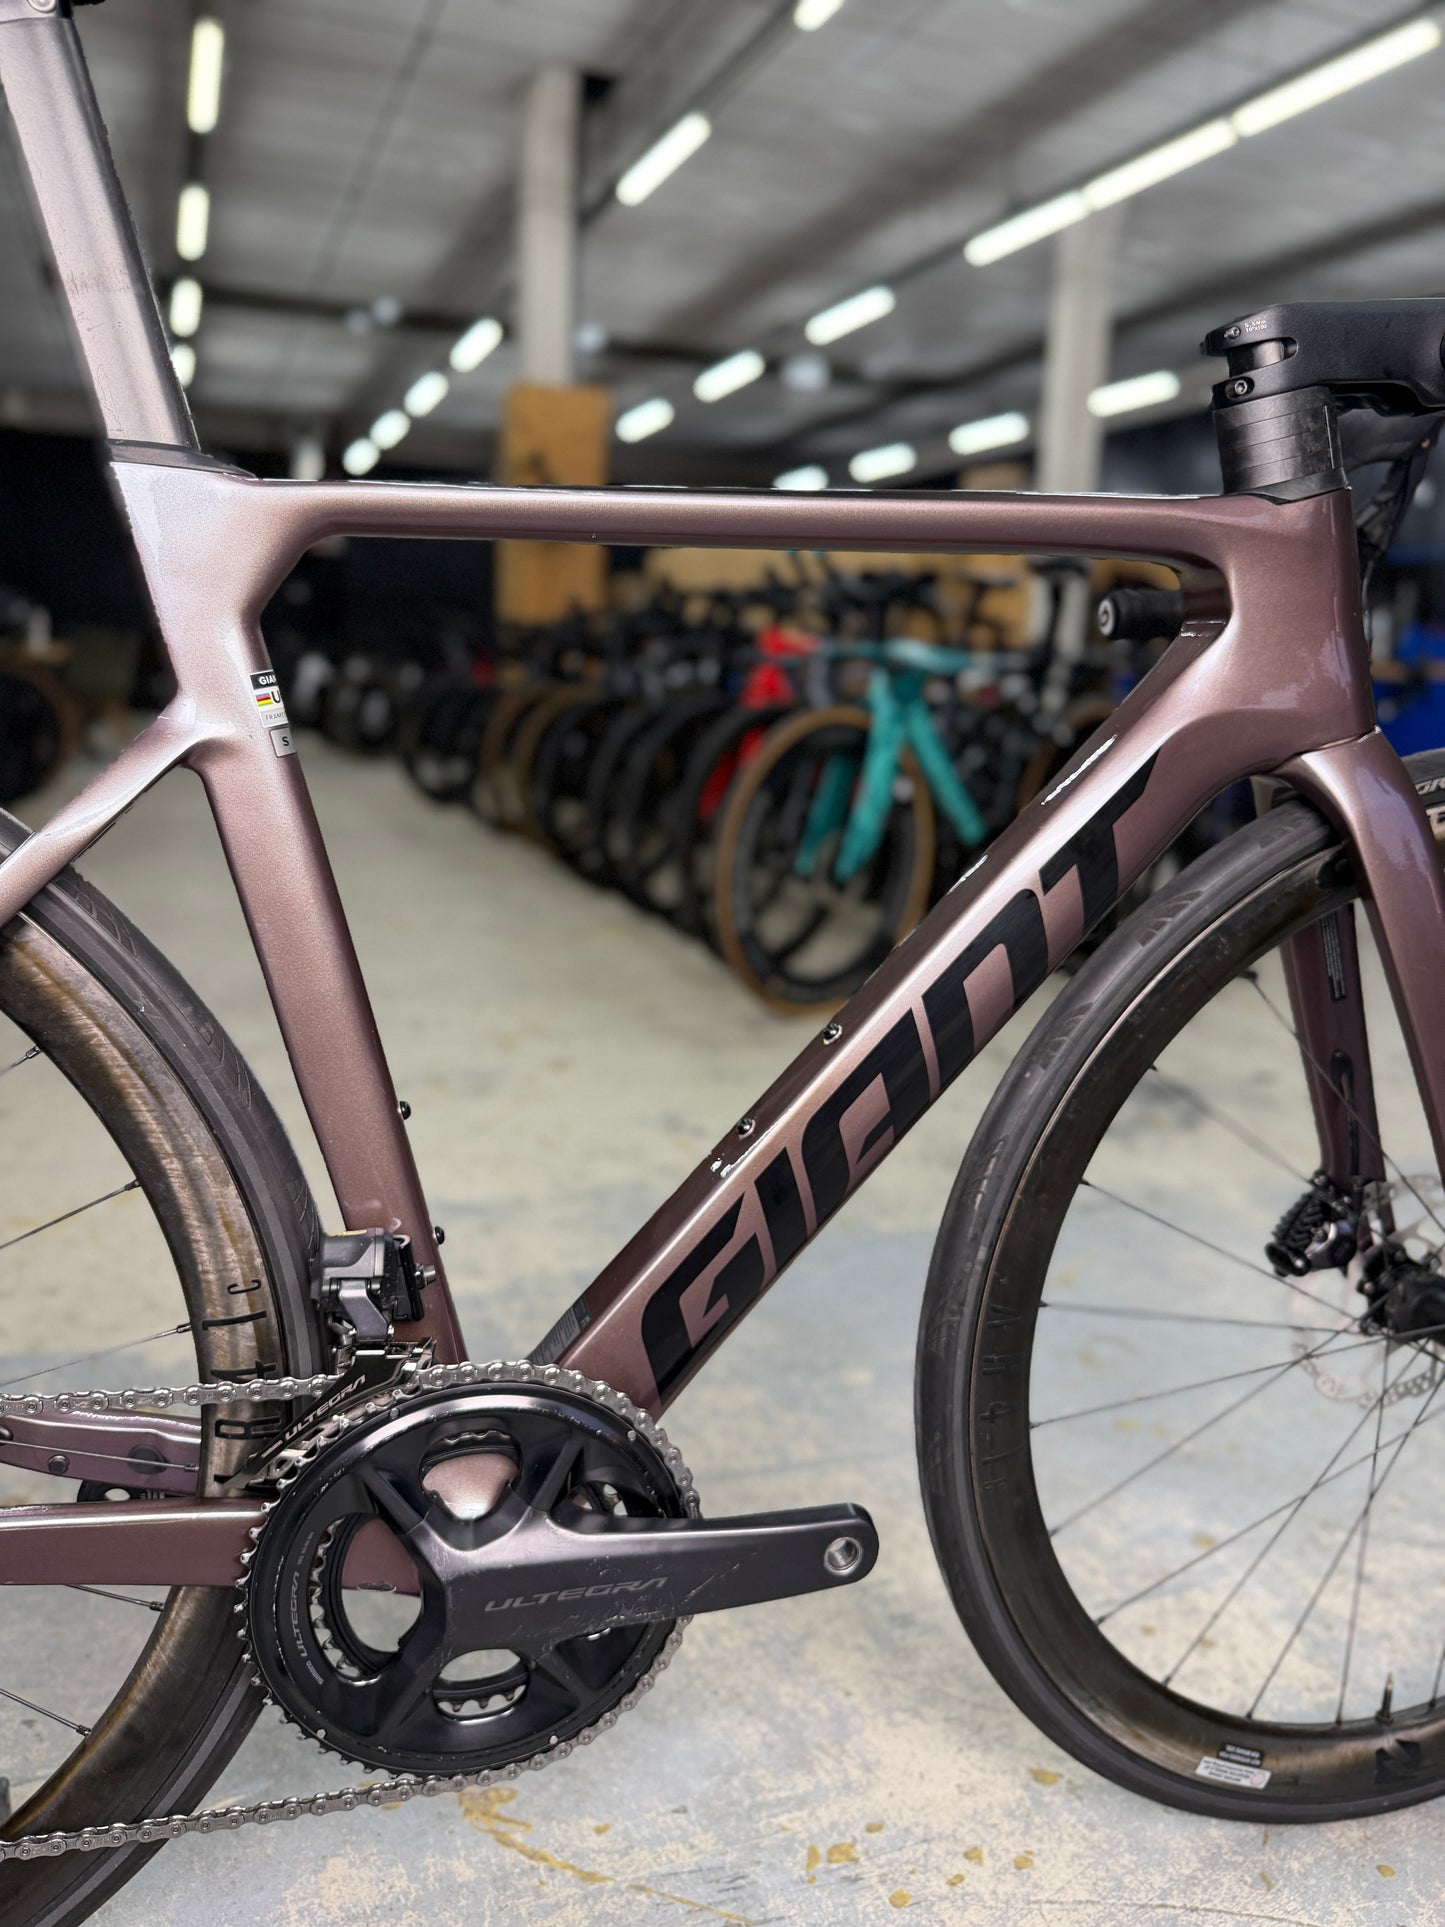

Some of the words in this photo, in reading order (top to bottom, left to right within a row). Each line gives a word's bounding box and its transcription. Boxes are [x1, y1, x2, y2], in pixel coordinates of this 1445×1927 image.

[282, 736, 290, 747] S
[641, 745, 1162, 1403] GIANT
[285, 1374, 366, 1439] ULTEGRA
[291, 1570, 308, 1658] ULTEGRA
[484, 1576, 669, 1612] ULTEGRA
